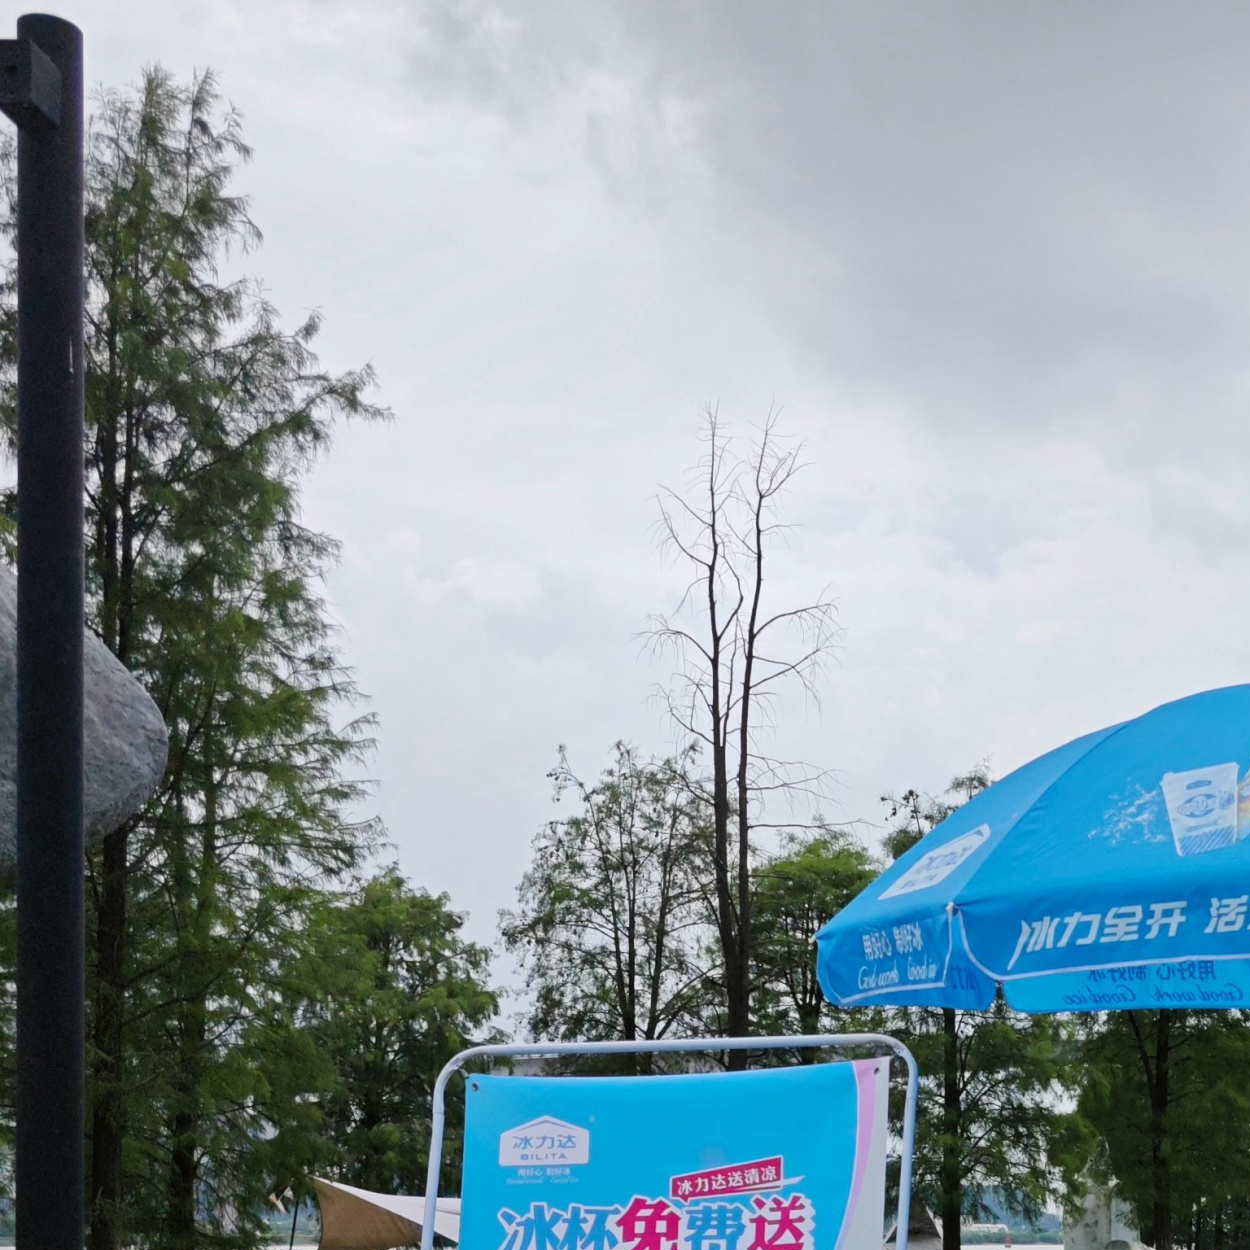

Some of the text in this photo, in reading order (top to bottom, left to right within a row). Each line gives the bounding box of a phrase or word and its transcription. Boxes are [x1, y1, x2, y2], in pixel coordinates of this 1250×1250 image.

[1006, 901, 1188, 971] 冰力全开
[513, 1134, 576, 1150] 冰力达
[676, 1165, 778, 1196] 冰力达送清凉
